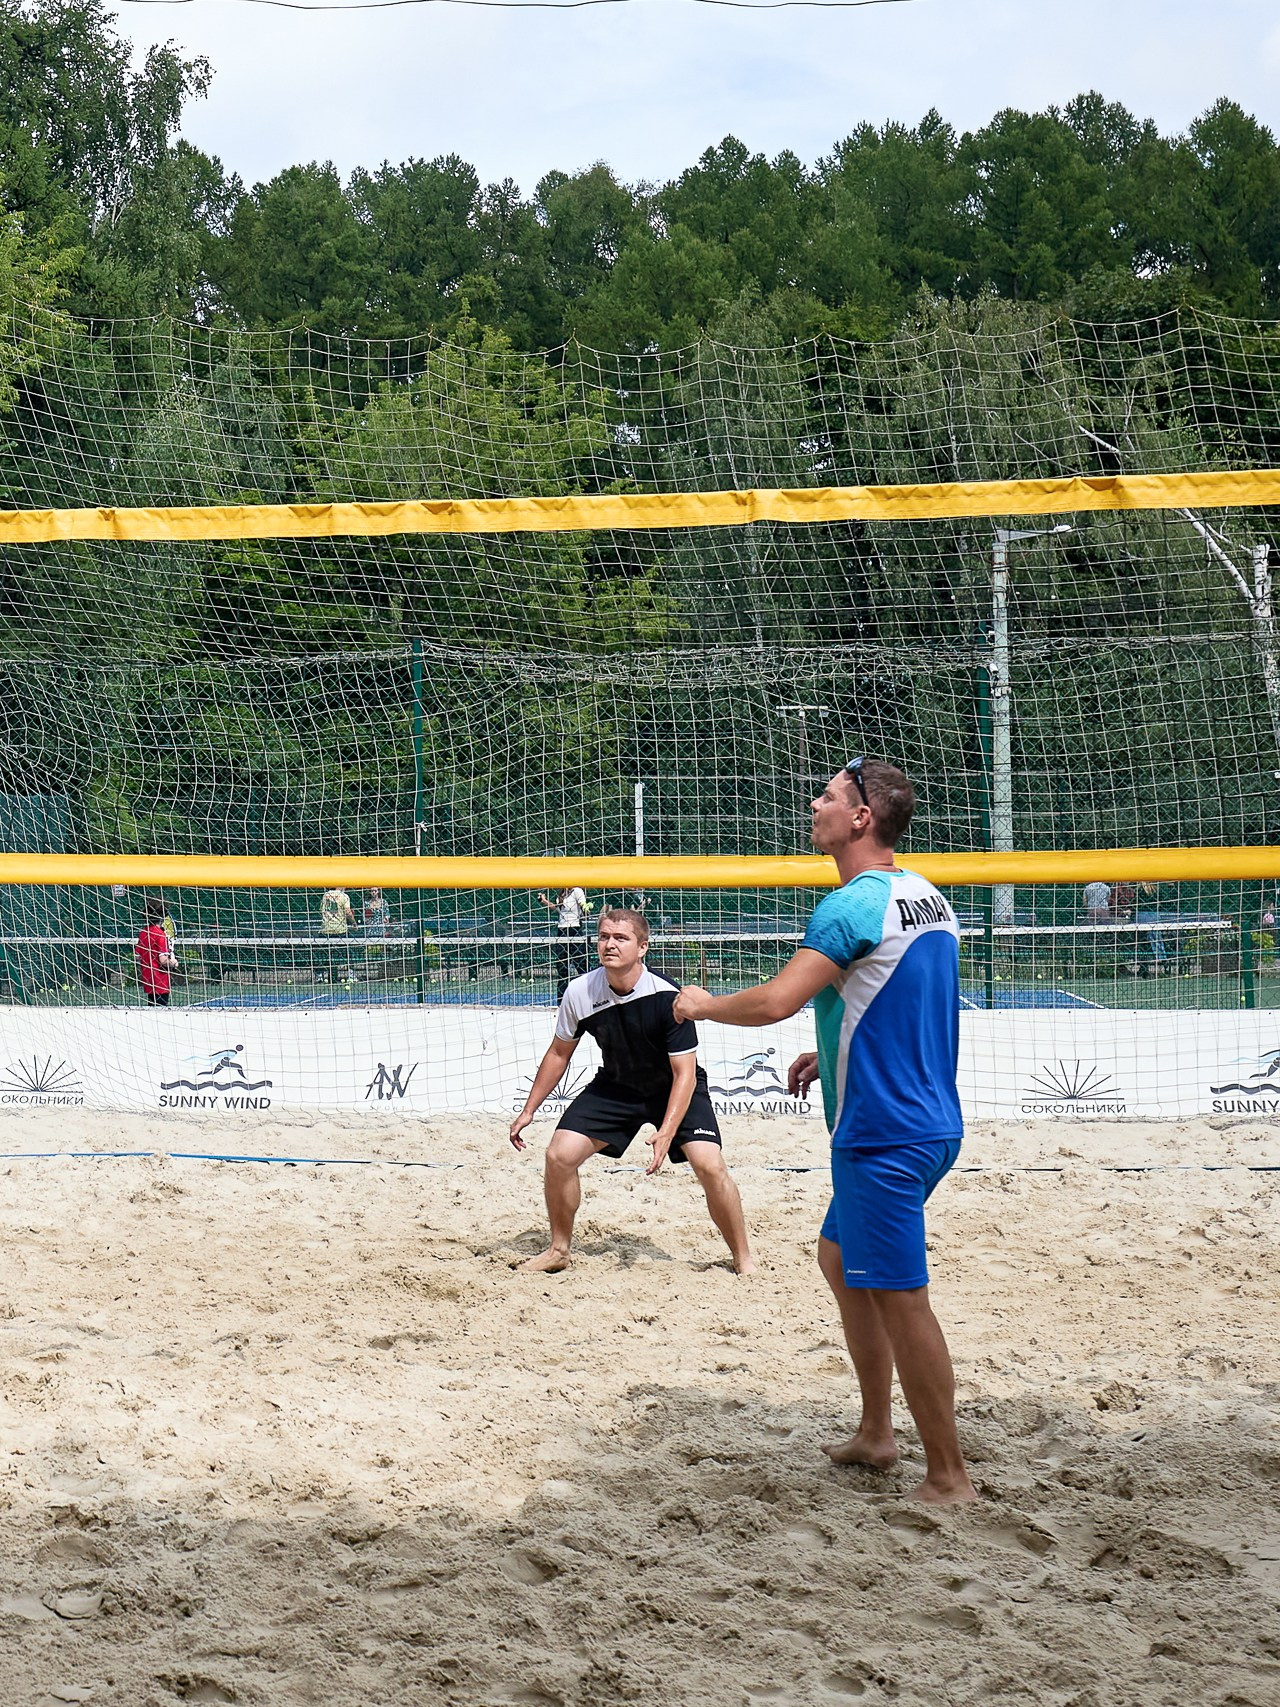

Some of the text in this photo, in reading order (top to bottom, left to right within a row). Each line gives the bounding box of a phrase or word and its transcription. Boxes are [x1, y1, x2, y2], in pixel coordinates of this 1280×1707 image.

[158, 1094, 271, 1110] SUNNY WIND
[759, 1101, 811, 1115] WIND
[1020, 1103, 1127, 1115] СОКОЛЬНИКИ
[1212, 1099, 1280, 1114] SUNNY
